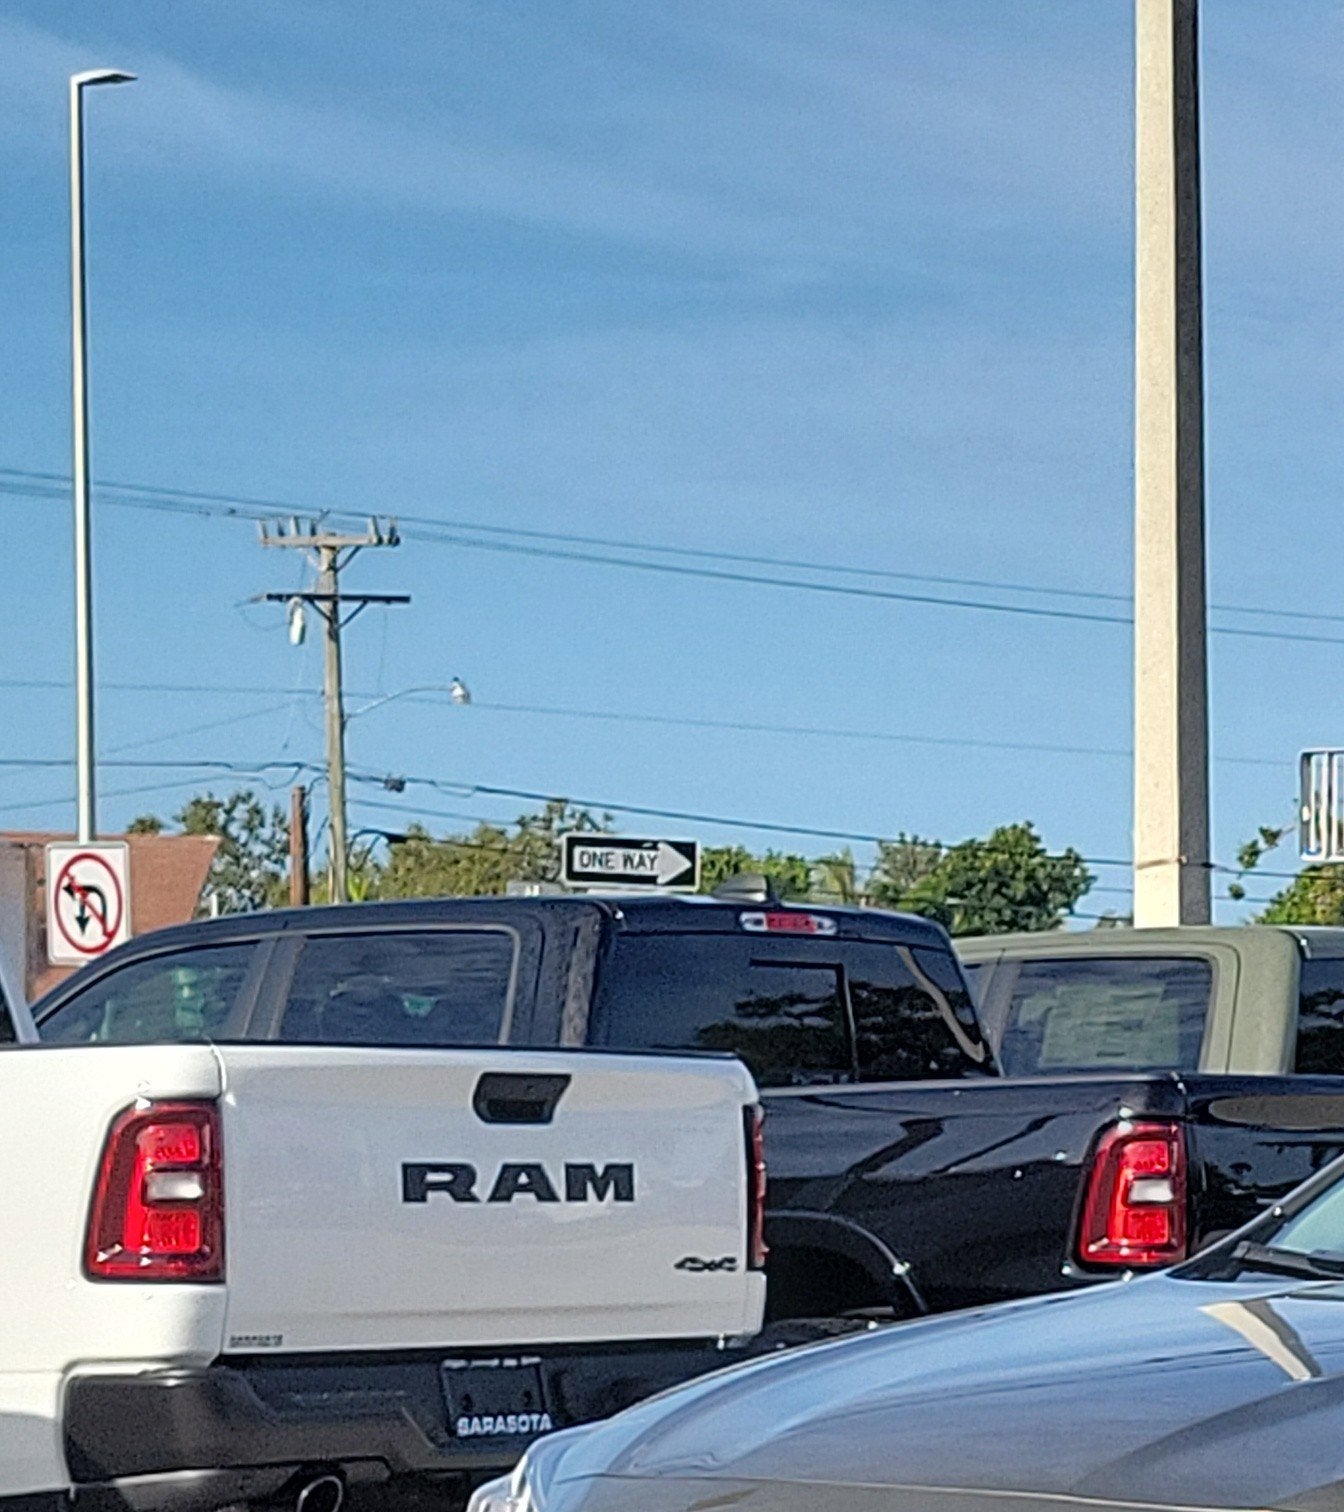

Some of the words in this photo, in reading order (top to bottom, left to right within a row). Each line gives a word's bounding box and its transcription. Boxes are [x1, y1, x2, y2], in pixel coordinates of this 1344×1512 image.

[580, 850, 615, 870] ONE
[622, 853, 658, 871] WAY
[401, 1162, 635, 1202] RAM
[457, 1413, 552, 1437] SARASOTA
